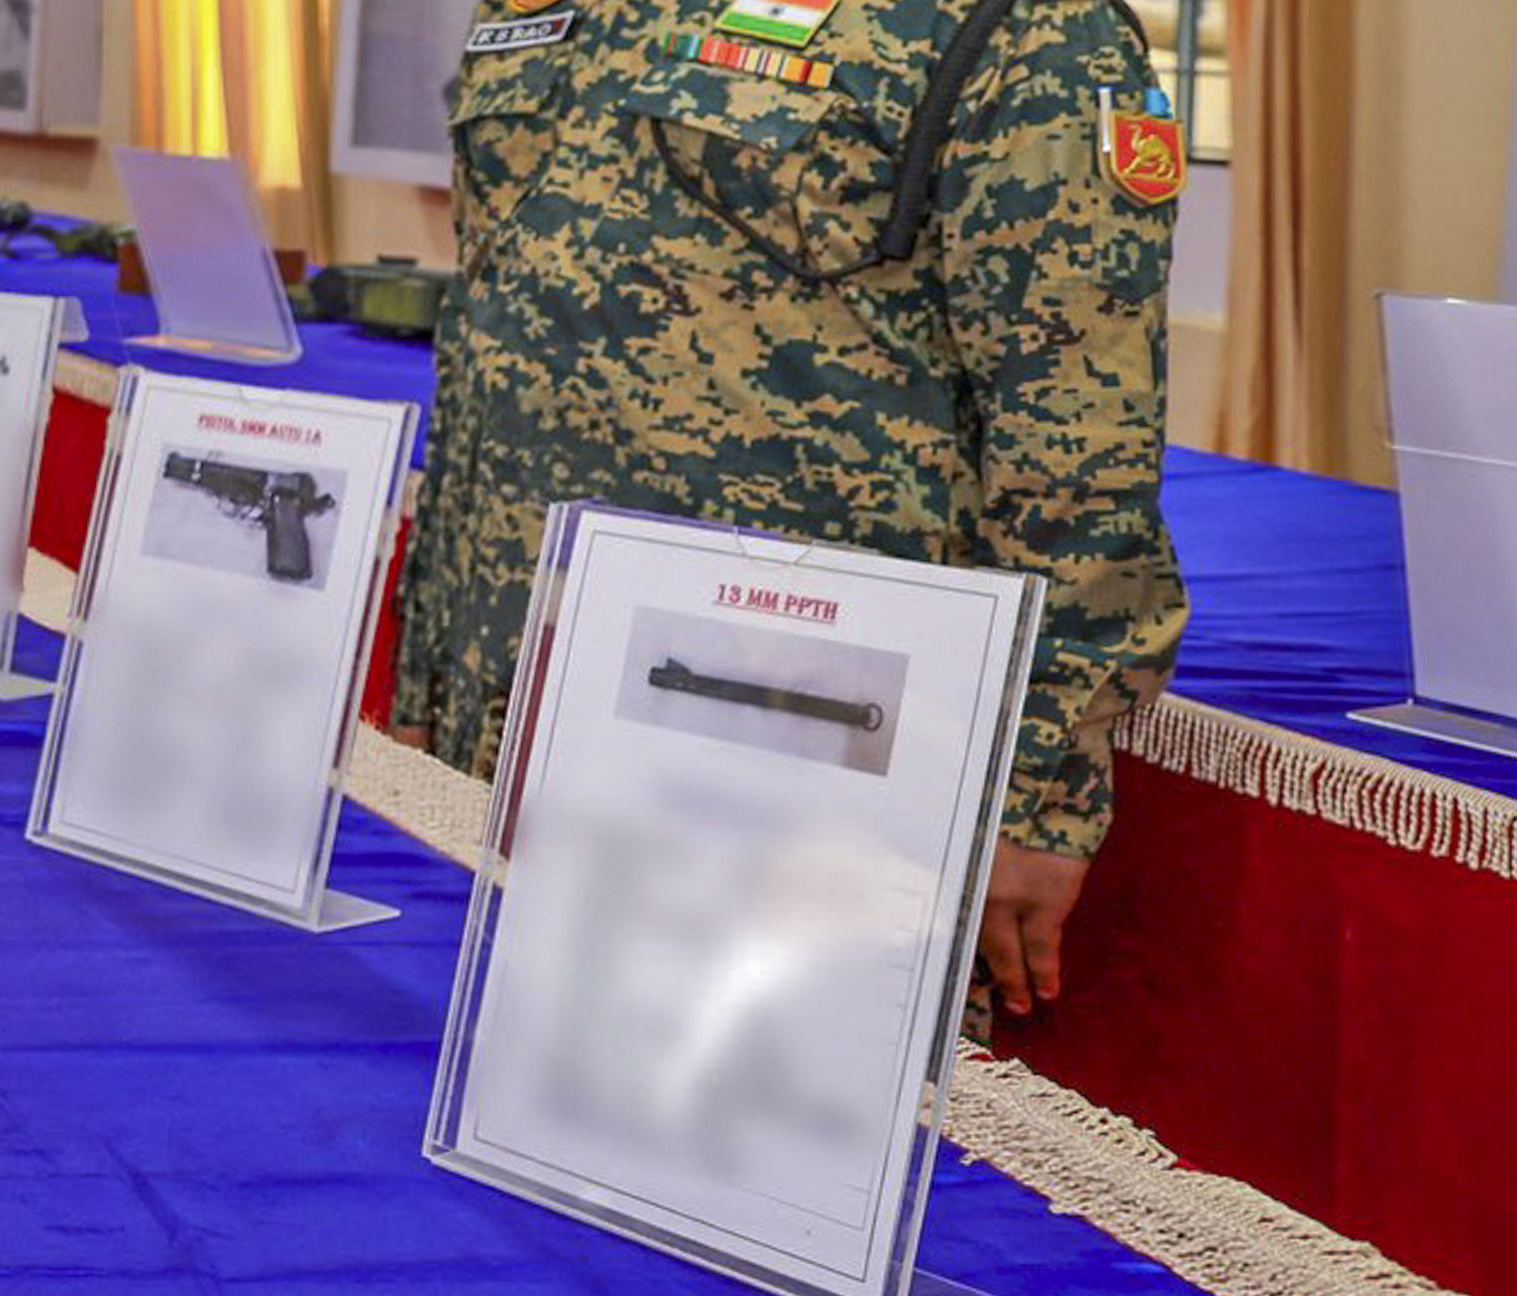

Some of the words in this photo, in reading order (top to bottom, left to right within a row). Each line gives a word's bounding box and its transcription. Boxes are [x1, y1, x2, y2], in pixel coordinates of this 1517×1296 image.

[717, 583, 742, 604] 13
[747, 587, 779, 610] MM
[785, 593, 839, 620] PPTH
